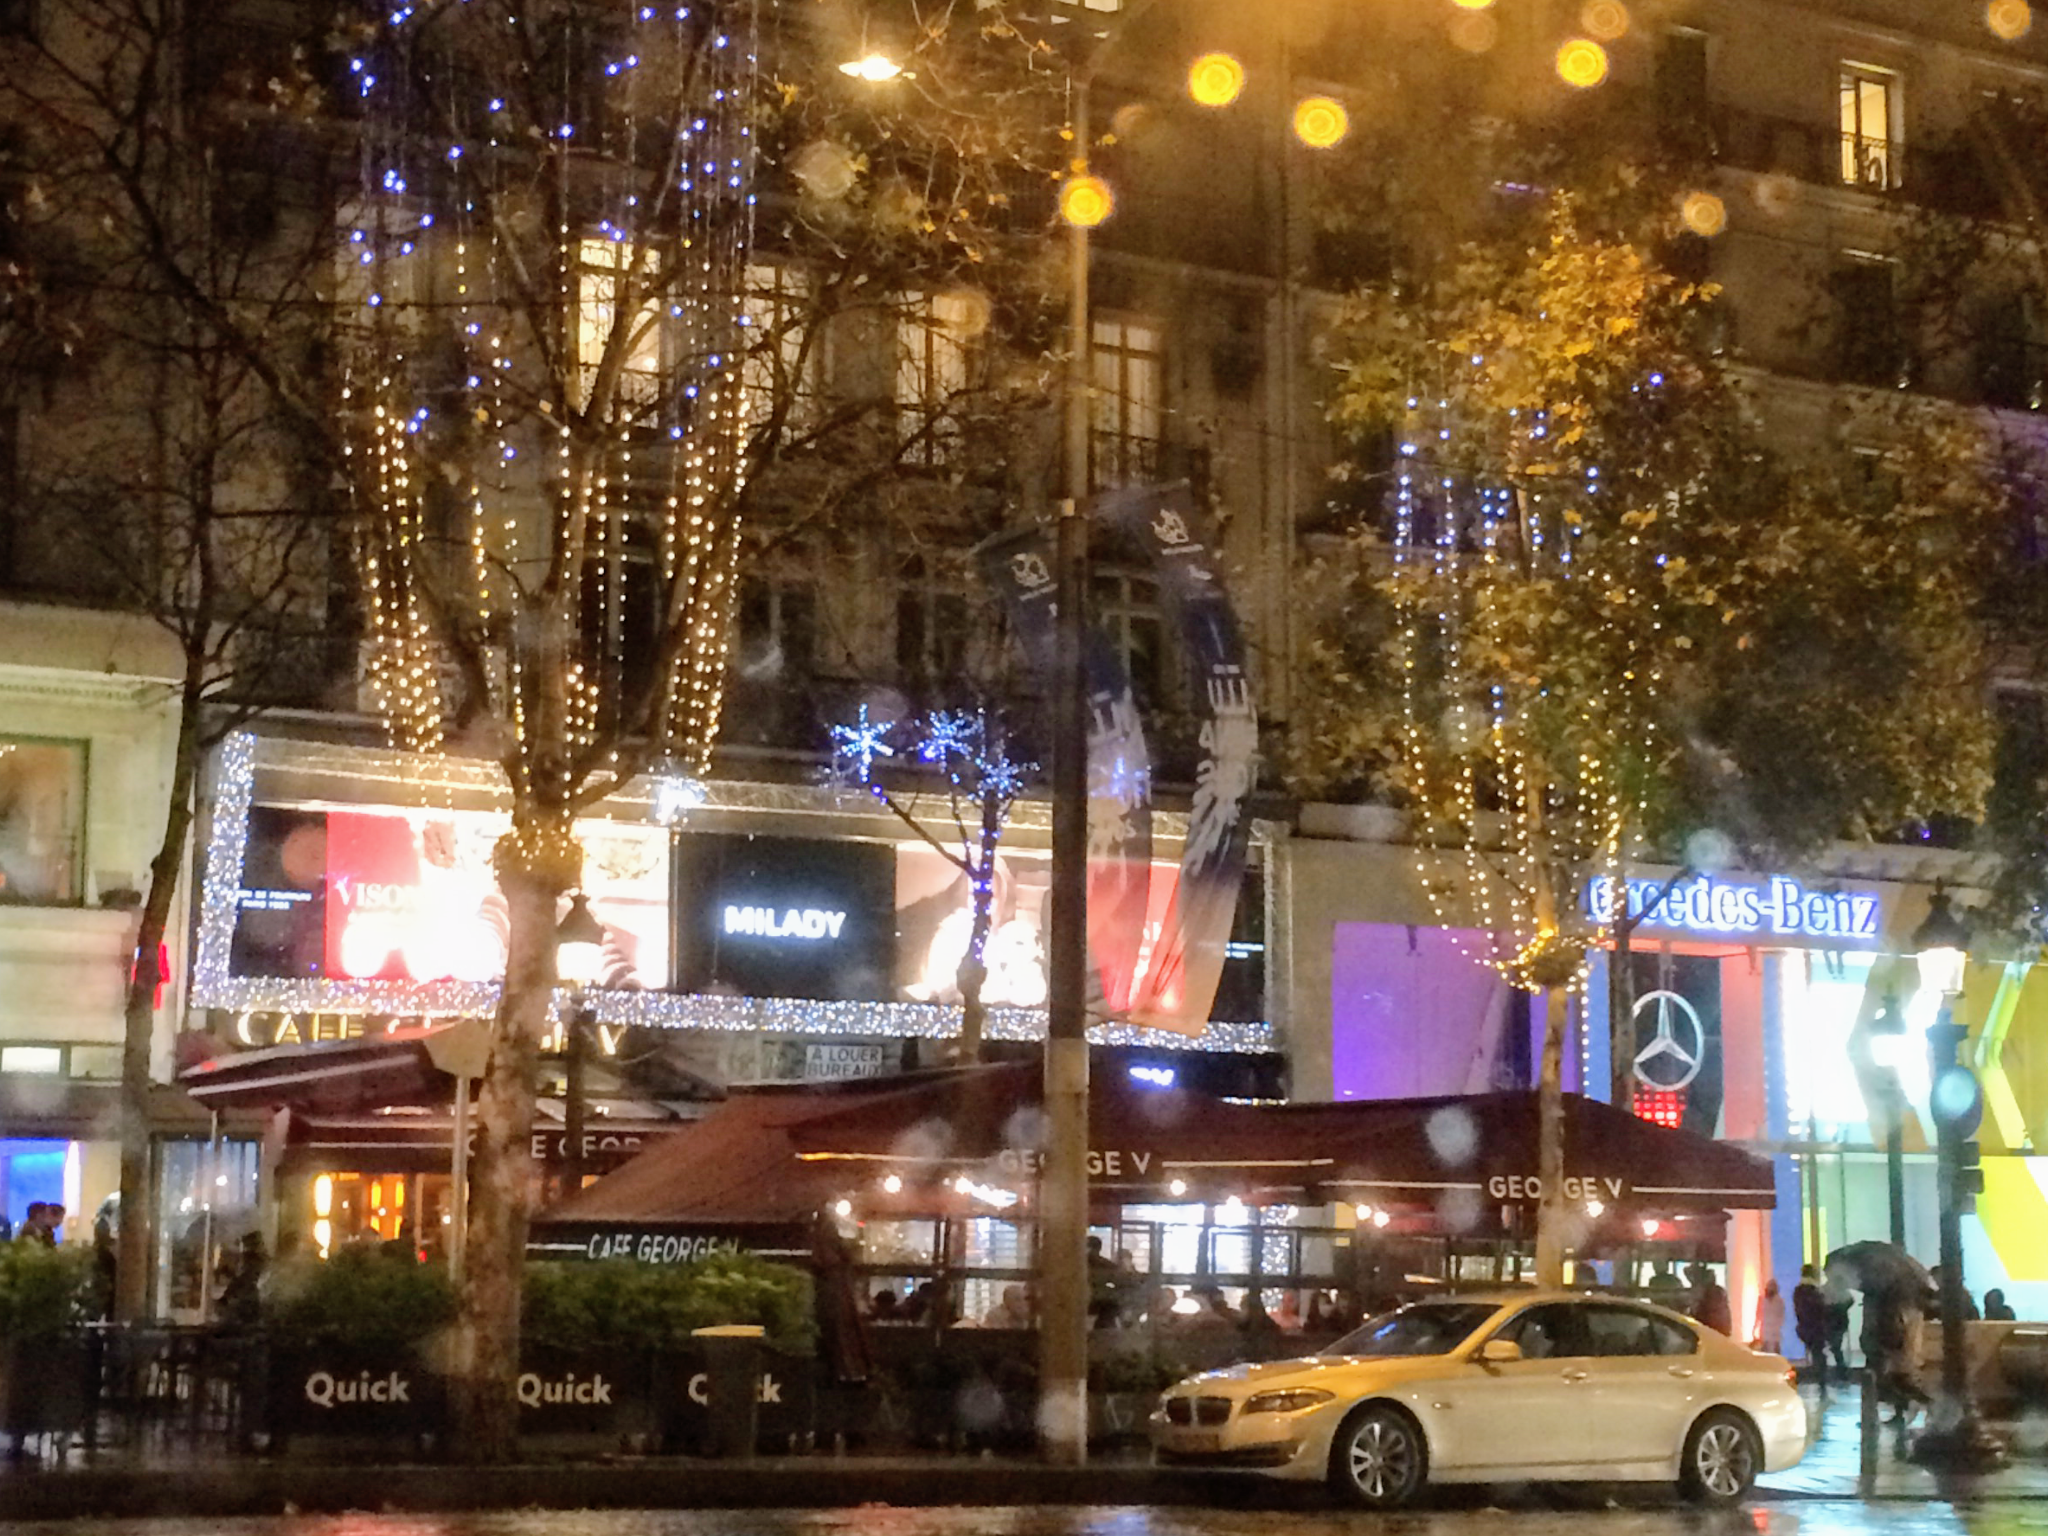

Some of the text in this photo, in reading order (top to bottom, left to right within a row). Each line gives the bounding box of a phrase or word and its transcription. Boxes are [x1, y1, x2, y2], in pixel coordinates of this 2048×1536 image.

[724, 905, 847, 938] MILADY
[829, 1047, 879, 1062] LOUER
[807, 1063, 881, 1078] BUREAUX
[1131, 1152, 1150, 1175] V
[1604, 1178, 1622, 1199] V
[305, 1370, 409, 1408] Quick
[517, 1372, 611, 1408] Quick
